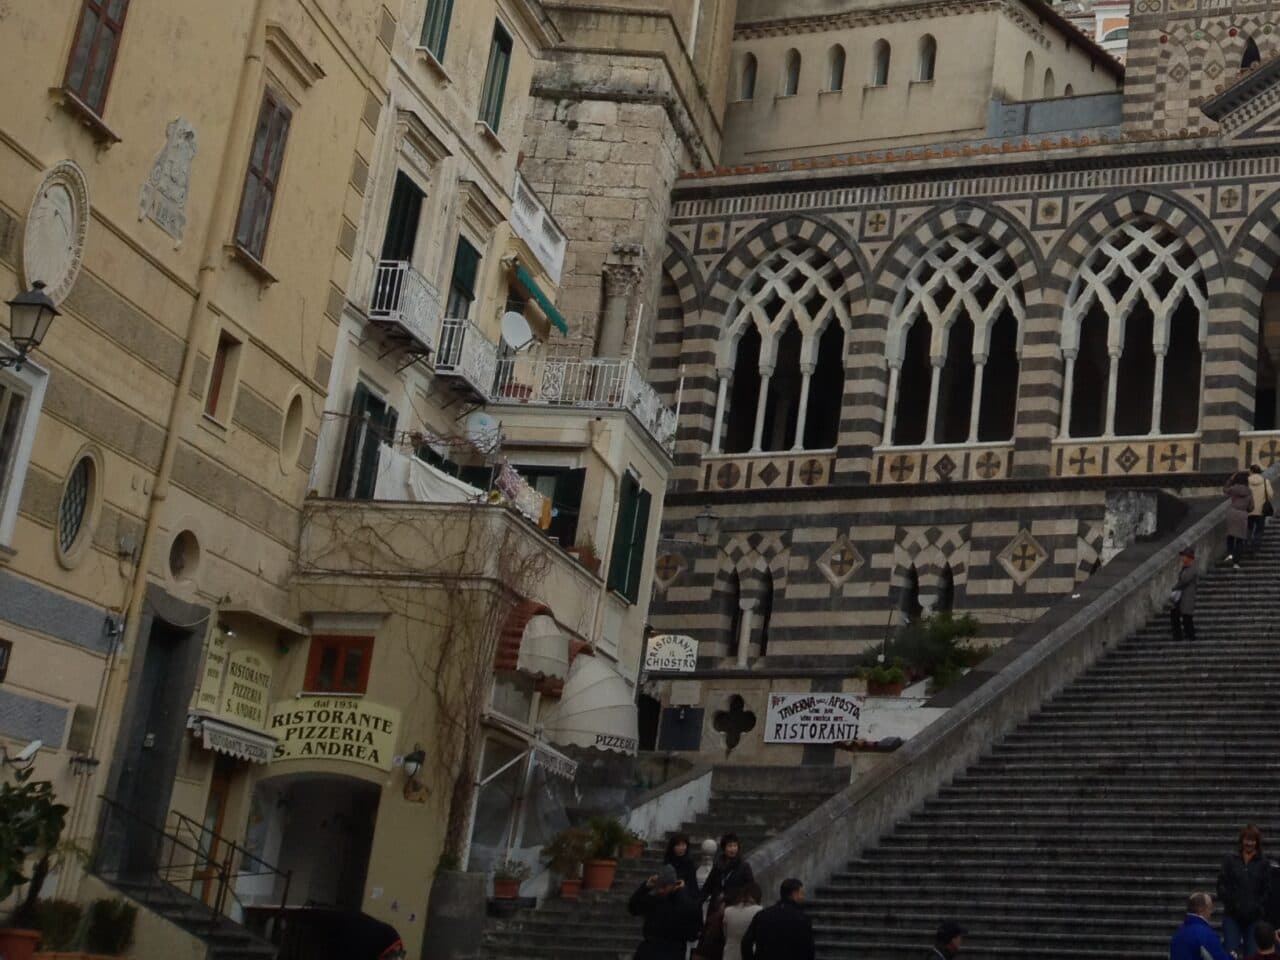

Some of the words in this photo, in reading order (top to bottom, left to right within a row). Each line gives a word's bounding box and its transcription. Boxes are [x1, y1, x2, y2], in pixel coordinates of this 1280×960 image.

[650, 636, 694, 658] RISTORANTE
[646, 657, 696, 668] CHIOSTRO
[230, 661, 271, 689] RISTORANTE
[231, 682, 262, 705] PIZZERIA
[313, 699, 330, 709] dal
[234, 701, 262, 722] ANDREA
[778, 696, 816, 720] TAVERNA
[271, 709, 393, 735] RISTORANTE
[285, 726, 374, 745] PIZZERIA
[272, 743, 291, 759] S.
[301, 742, 380, 764] ANDREA
